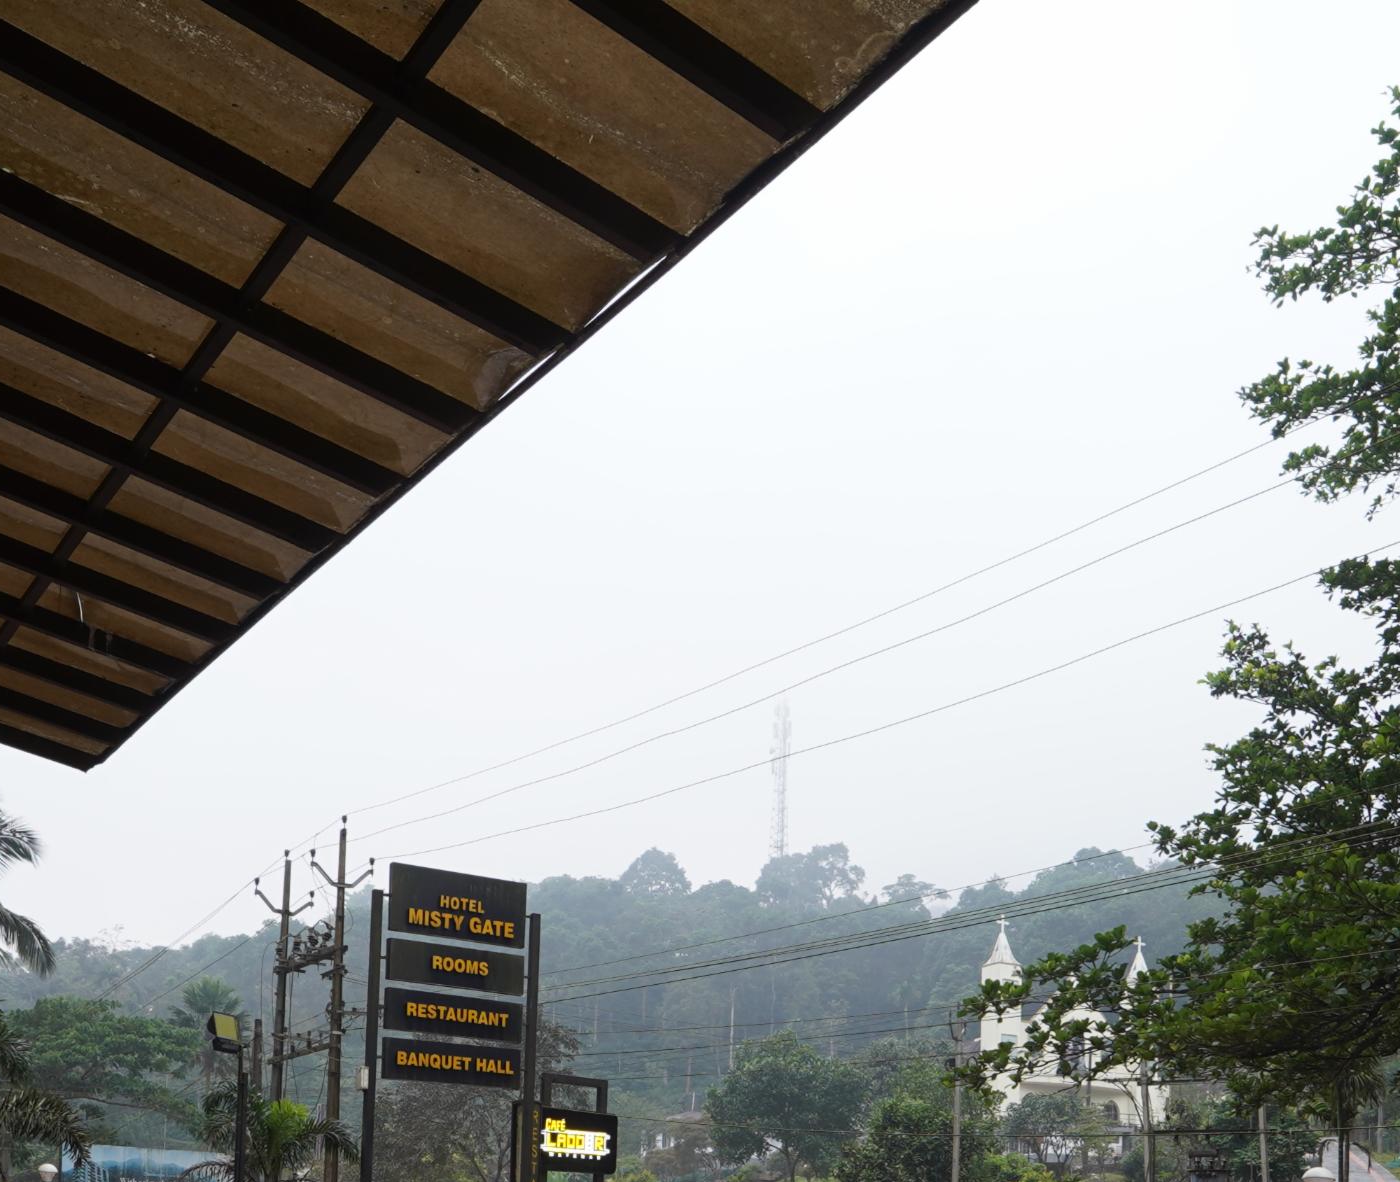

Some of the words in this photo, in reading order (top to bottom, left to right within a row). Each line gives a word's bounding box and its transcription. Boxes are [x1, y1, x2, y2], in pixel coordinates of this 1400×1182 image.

[440, 894, 485, 914] HOTEL
[408, 907, 464, 931] MISTY
[469, 916, 515, 939] GATE
[432, 955, 489, 976] ROOMS
[406, 1002, 509, 1027] RESTAURANT
[396, 1050, 472, 1071] BANQUET
[475, 1058, 515, 1075] HALL
[545, 1117, 566, 1132] CAFÉ
